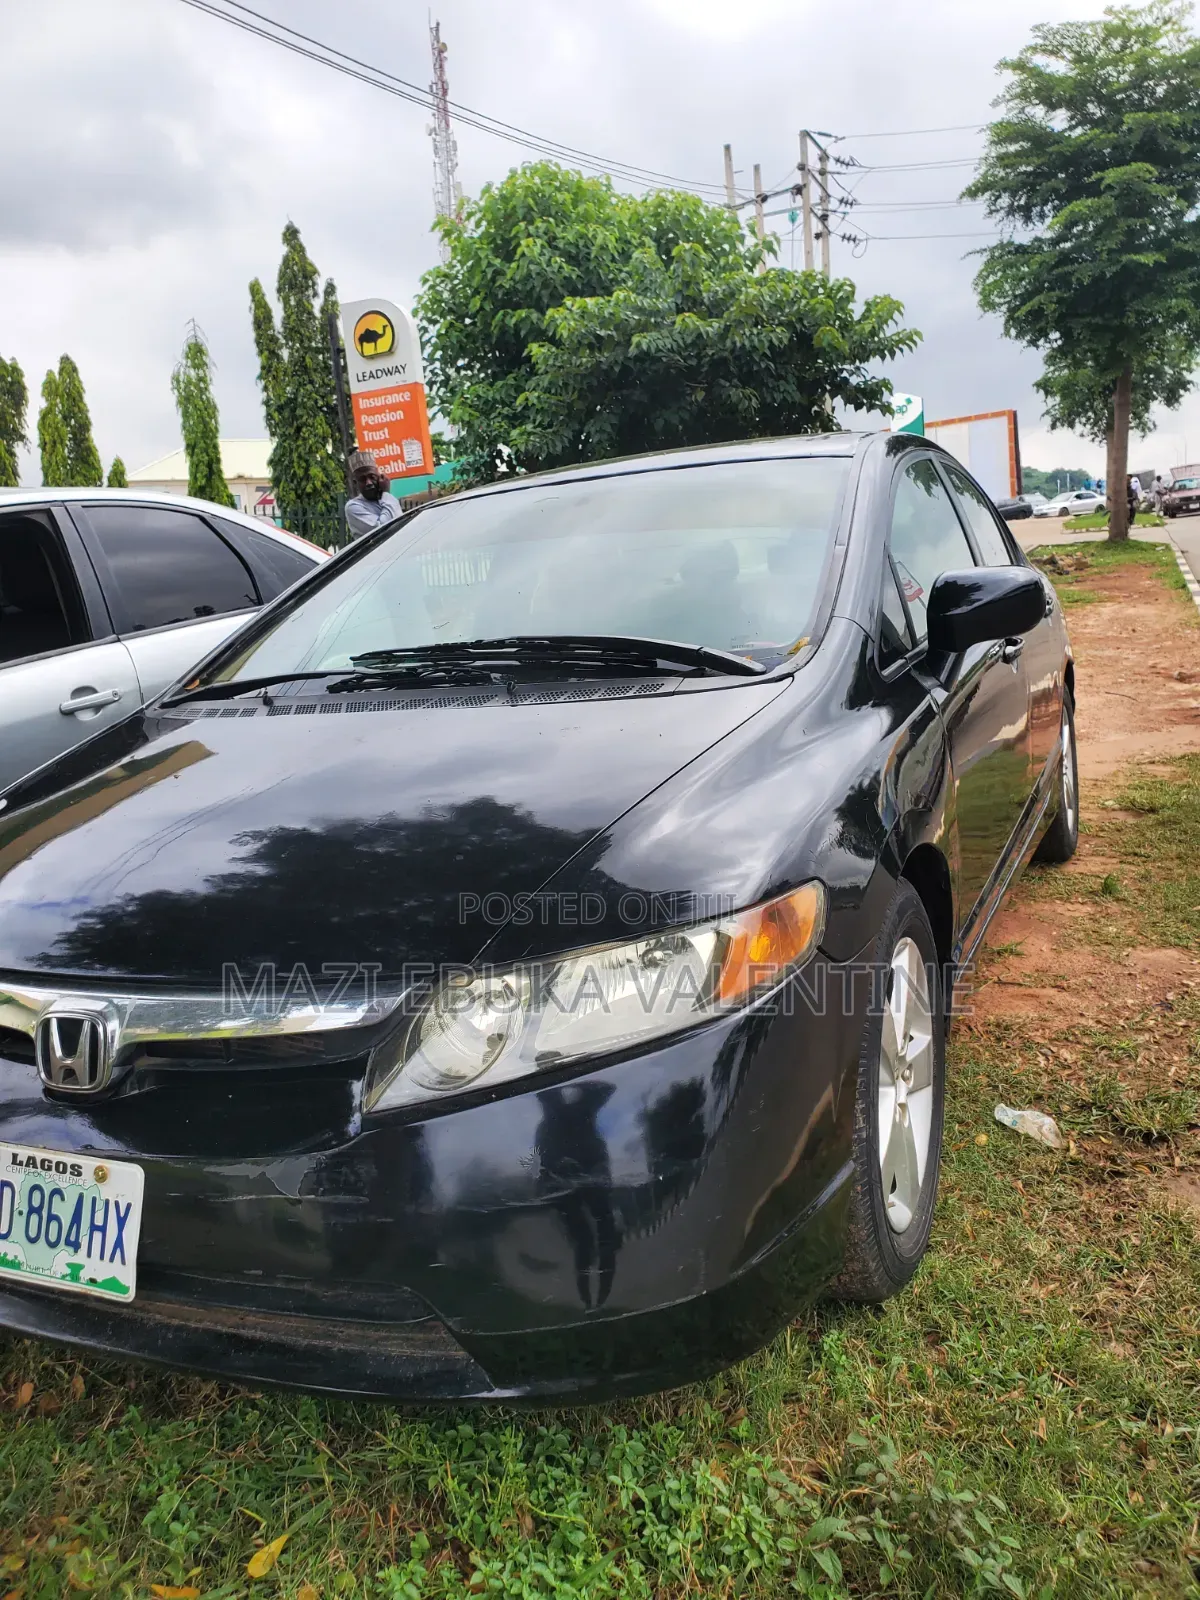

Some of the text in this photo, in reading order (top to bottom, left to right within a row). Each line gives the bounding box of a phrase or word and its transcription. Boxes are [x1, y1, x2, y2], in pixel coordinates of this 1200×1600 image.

[356, 363, 407, 383] LEADWAY
[359, 391, 411, 409] Insurance
[361, 409, 404, 426] Pension
[363, 427, 389, 442] Trust
[375, 459, 406, 474] ealth
[11, 1152, 83, 1177] LAGOS
[5, 1165, 32, 1177] CENTRE
[44, 1172, 88, 1187] EXCELLENCE
